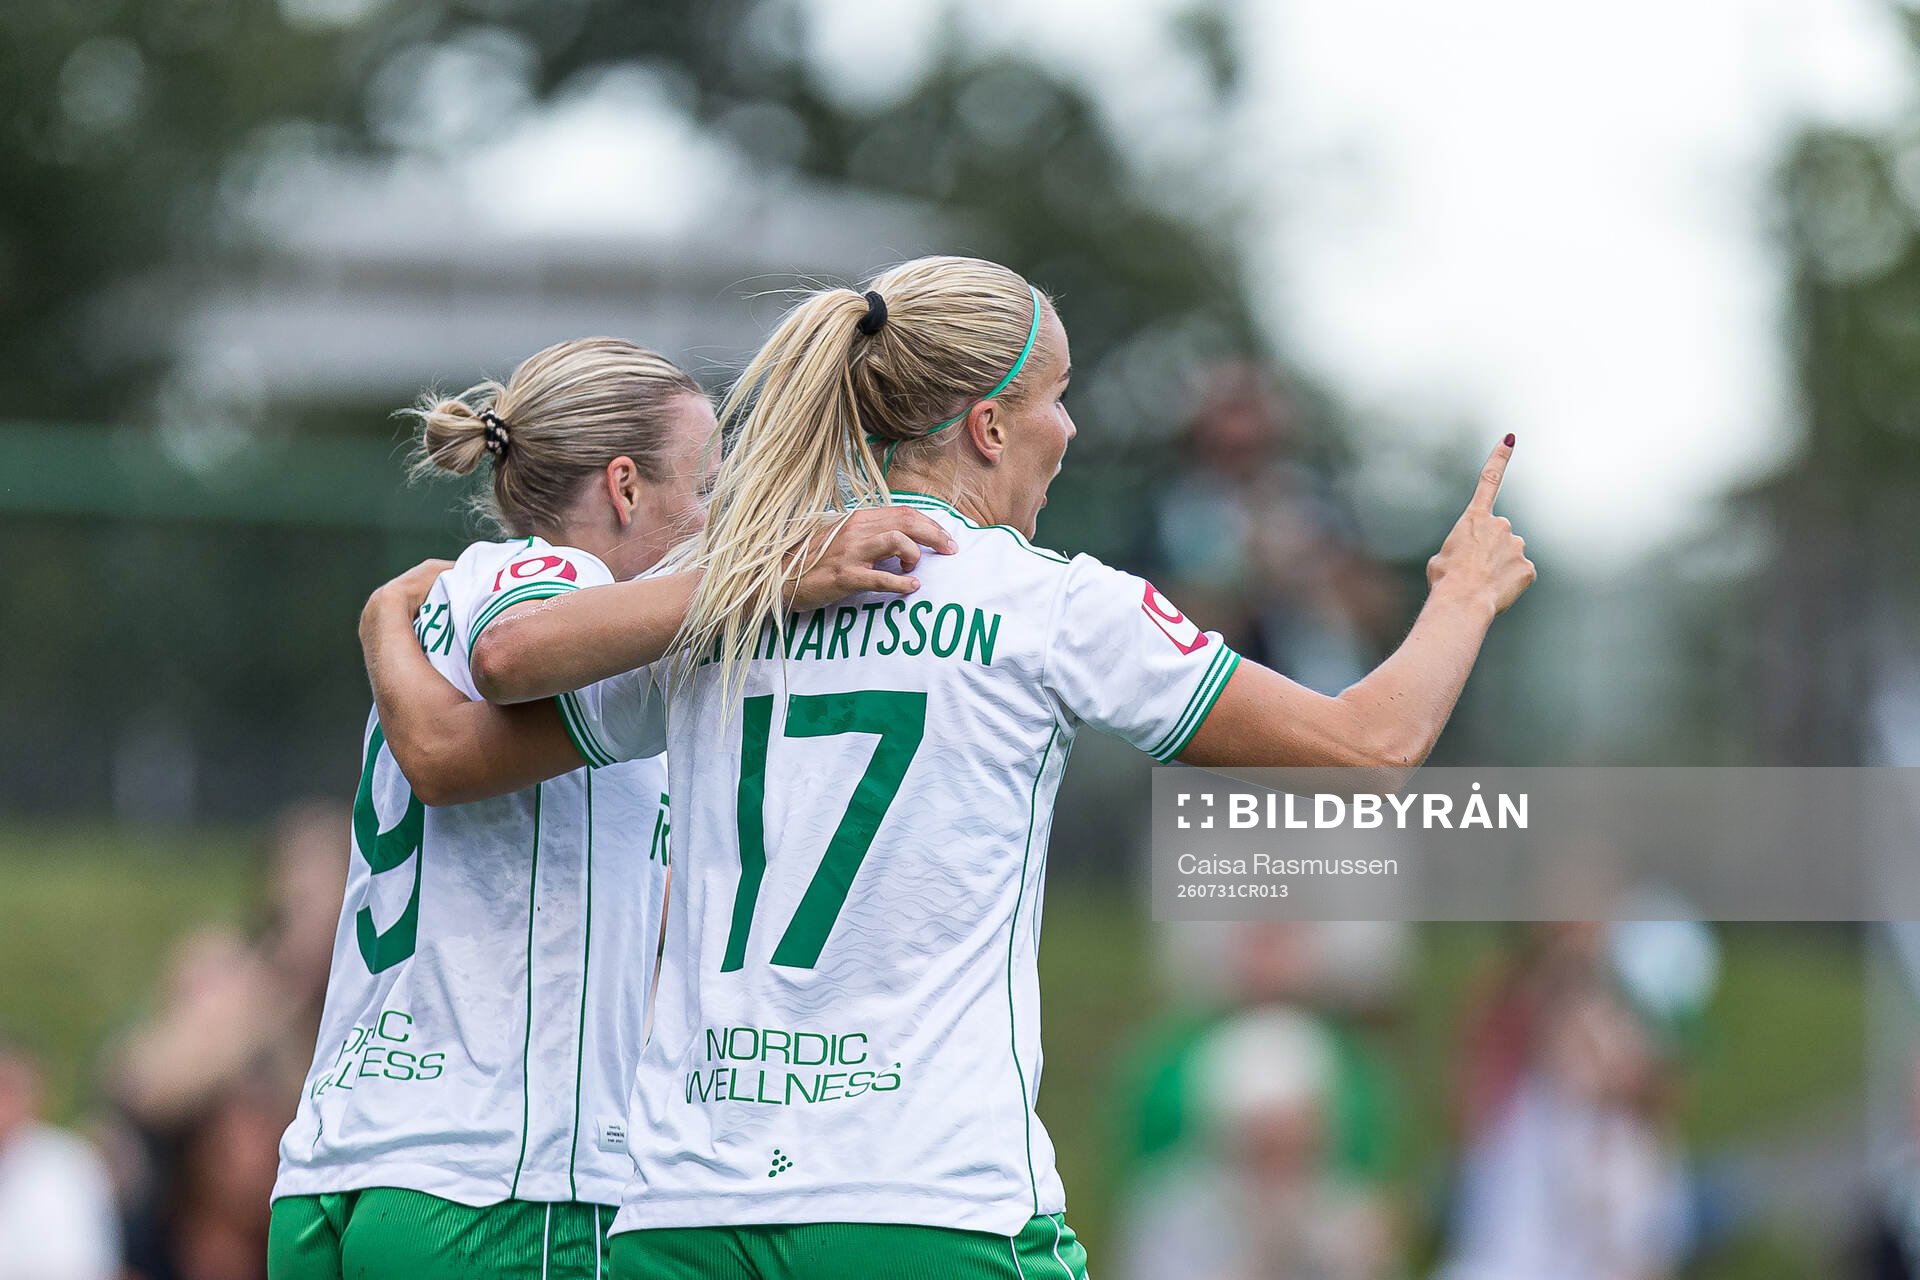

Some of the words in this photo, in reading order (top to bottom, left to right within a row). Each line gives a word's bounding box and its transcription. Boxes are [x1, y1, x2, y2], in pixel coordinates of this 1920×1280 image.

[697, 599, 1001, 666] NARTSSON
[353, 722, 425, 975] 9
[720, 690, 928, 972] 17
[706, 1027, 868, 1066] NORDIC
[685, 1062, 901, 1105] WELLNESS
